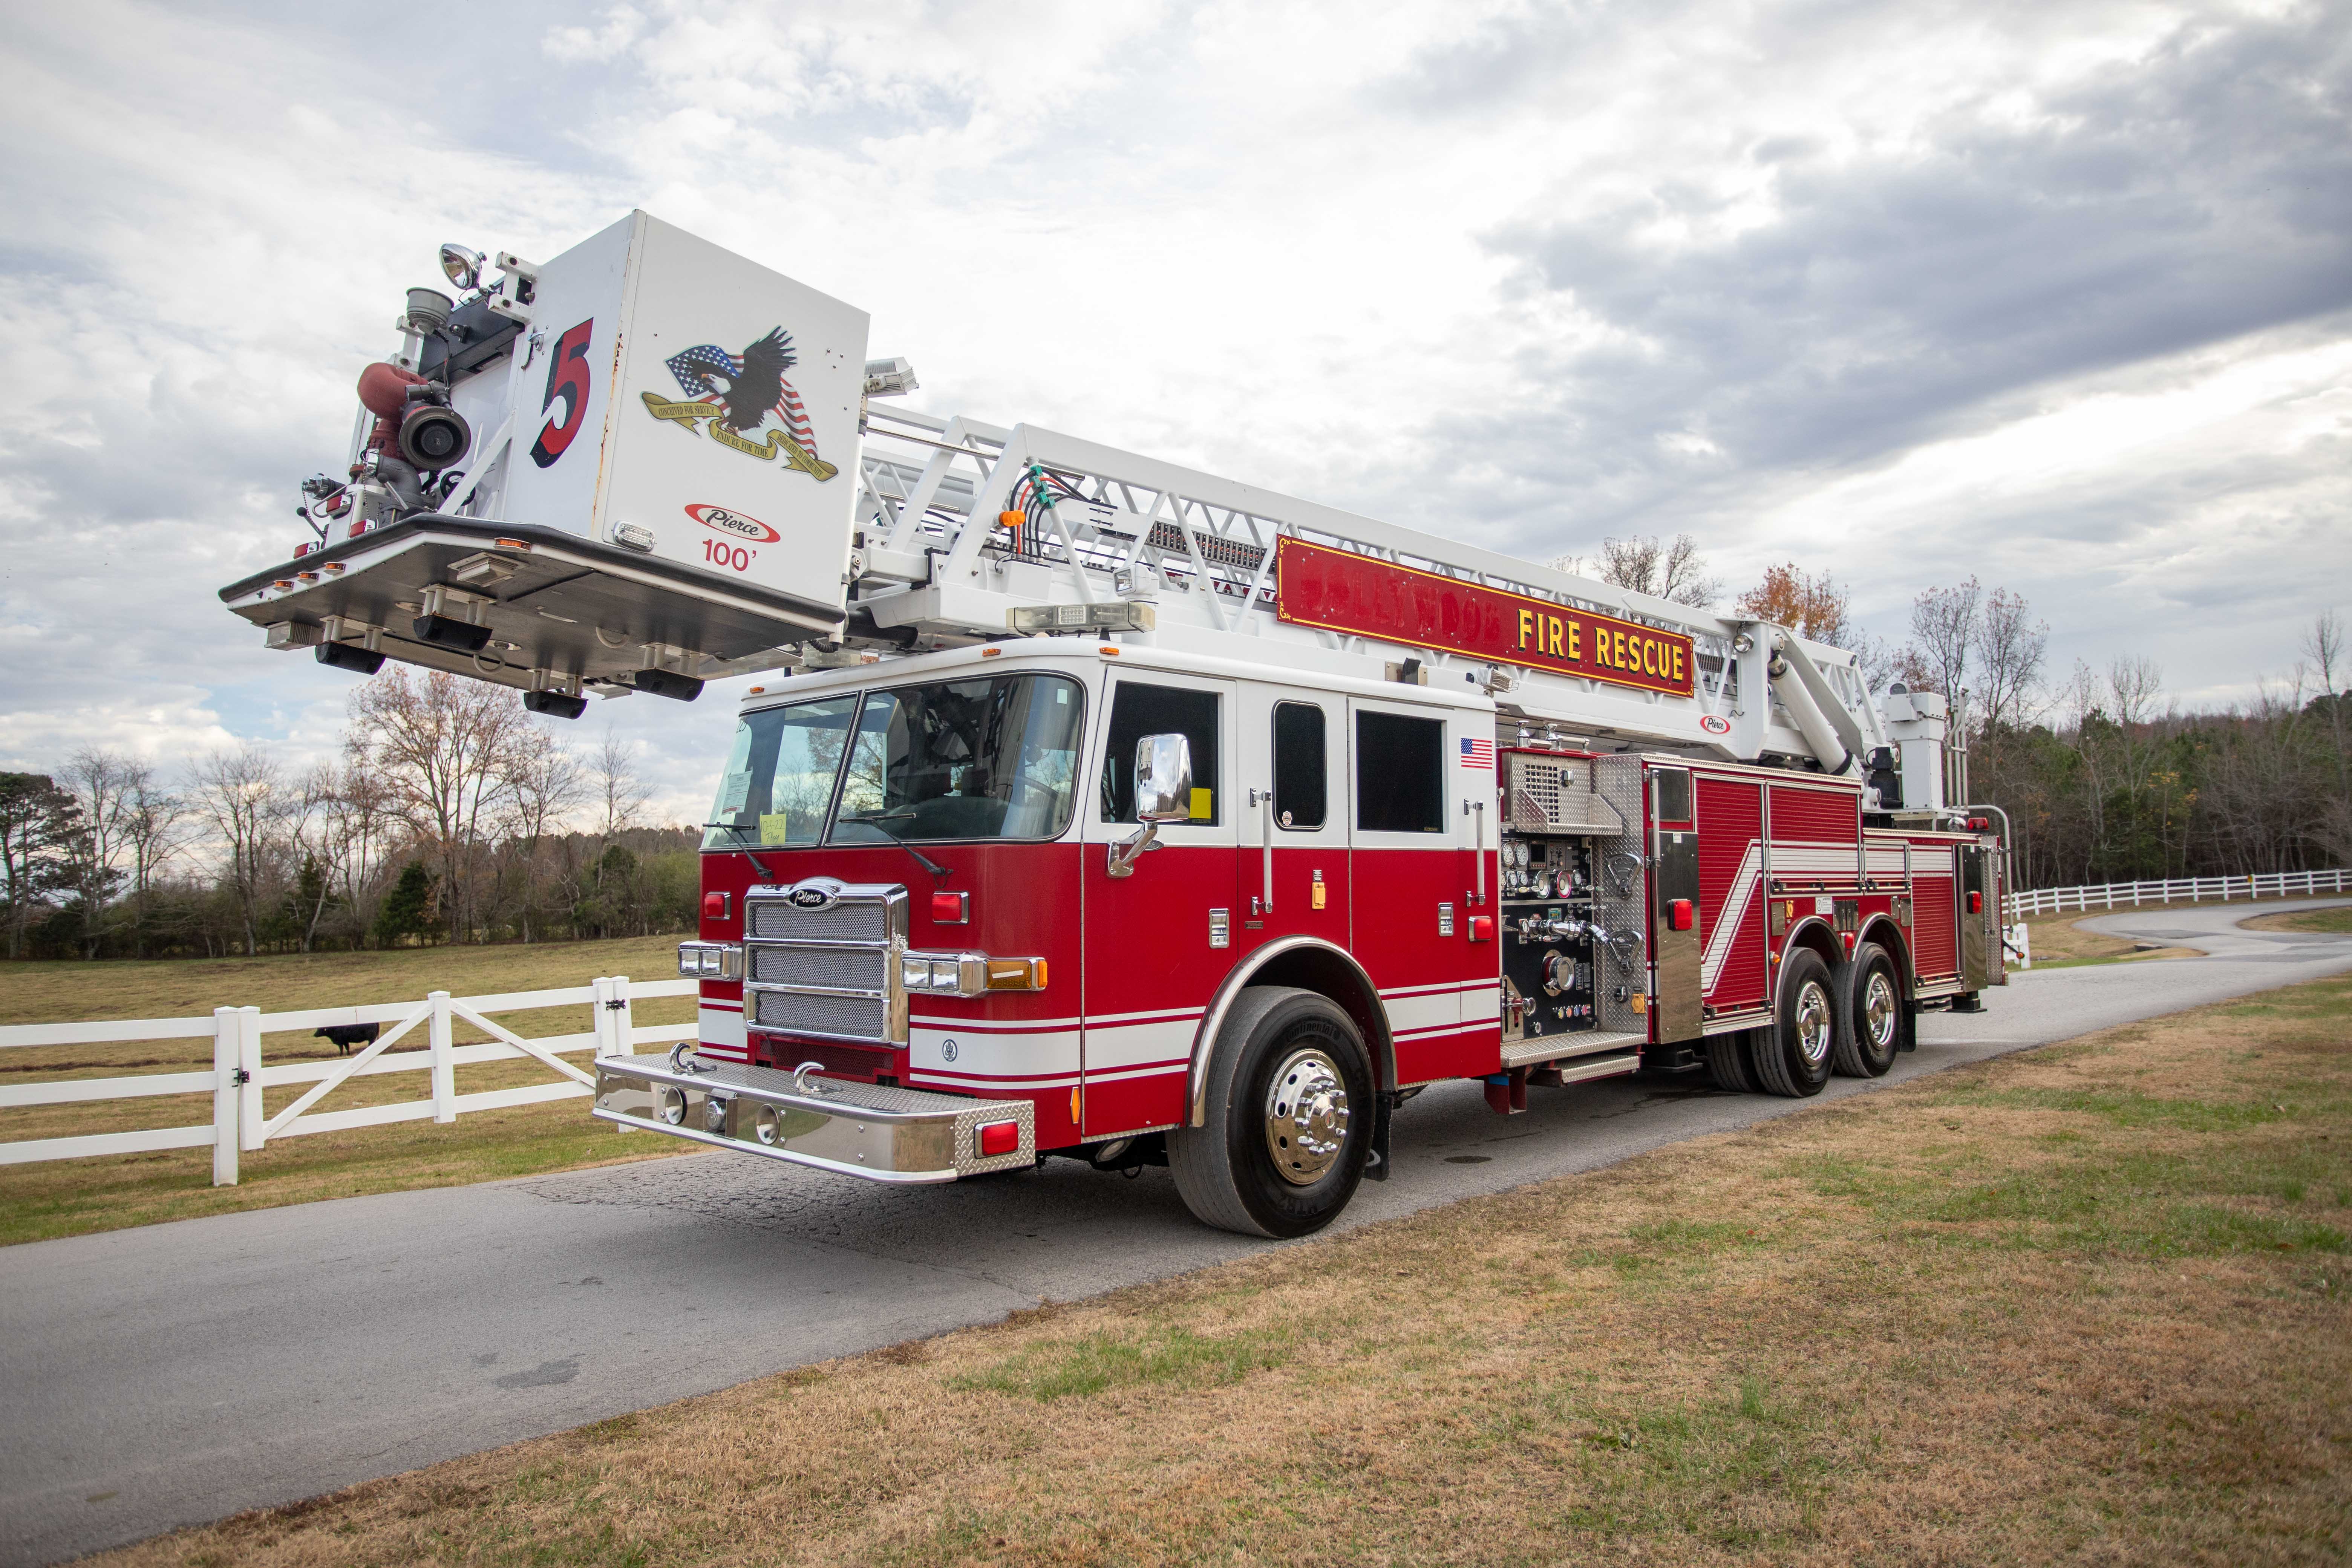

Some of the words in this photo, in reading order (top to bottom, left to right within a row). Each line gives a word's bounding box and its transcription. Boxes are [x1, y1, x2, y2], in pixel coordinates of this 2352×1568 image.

[530, 317, 594, 469] 5
[658, 406, 683, 416] CONCEIVED
[684, 405, 694, 415] FOR
[694, 405, 714, 415] SERVICE
[716, 430, 740, 447] ENDURE
[741, 440, 752, 452] FOR
[755, 446, 768, 457] TIME
[777, 433, 798, 454] DEDICATED
[797, 450, 803, 459] TO
[802, 453, 823, 477] COMMUNITY
[706, 509, 759, 535] Pierce
[1517, 608, 1580, 663] FIRE
[1594, 627, 1683, 683] RESCUE
[1707, 717, 1724, 730] Pierce
[794, 890, 822, 905] Pierce
